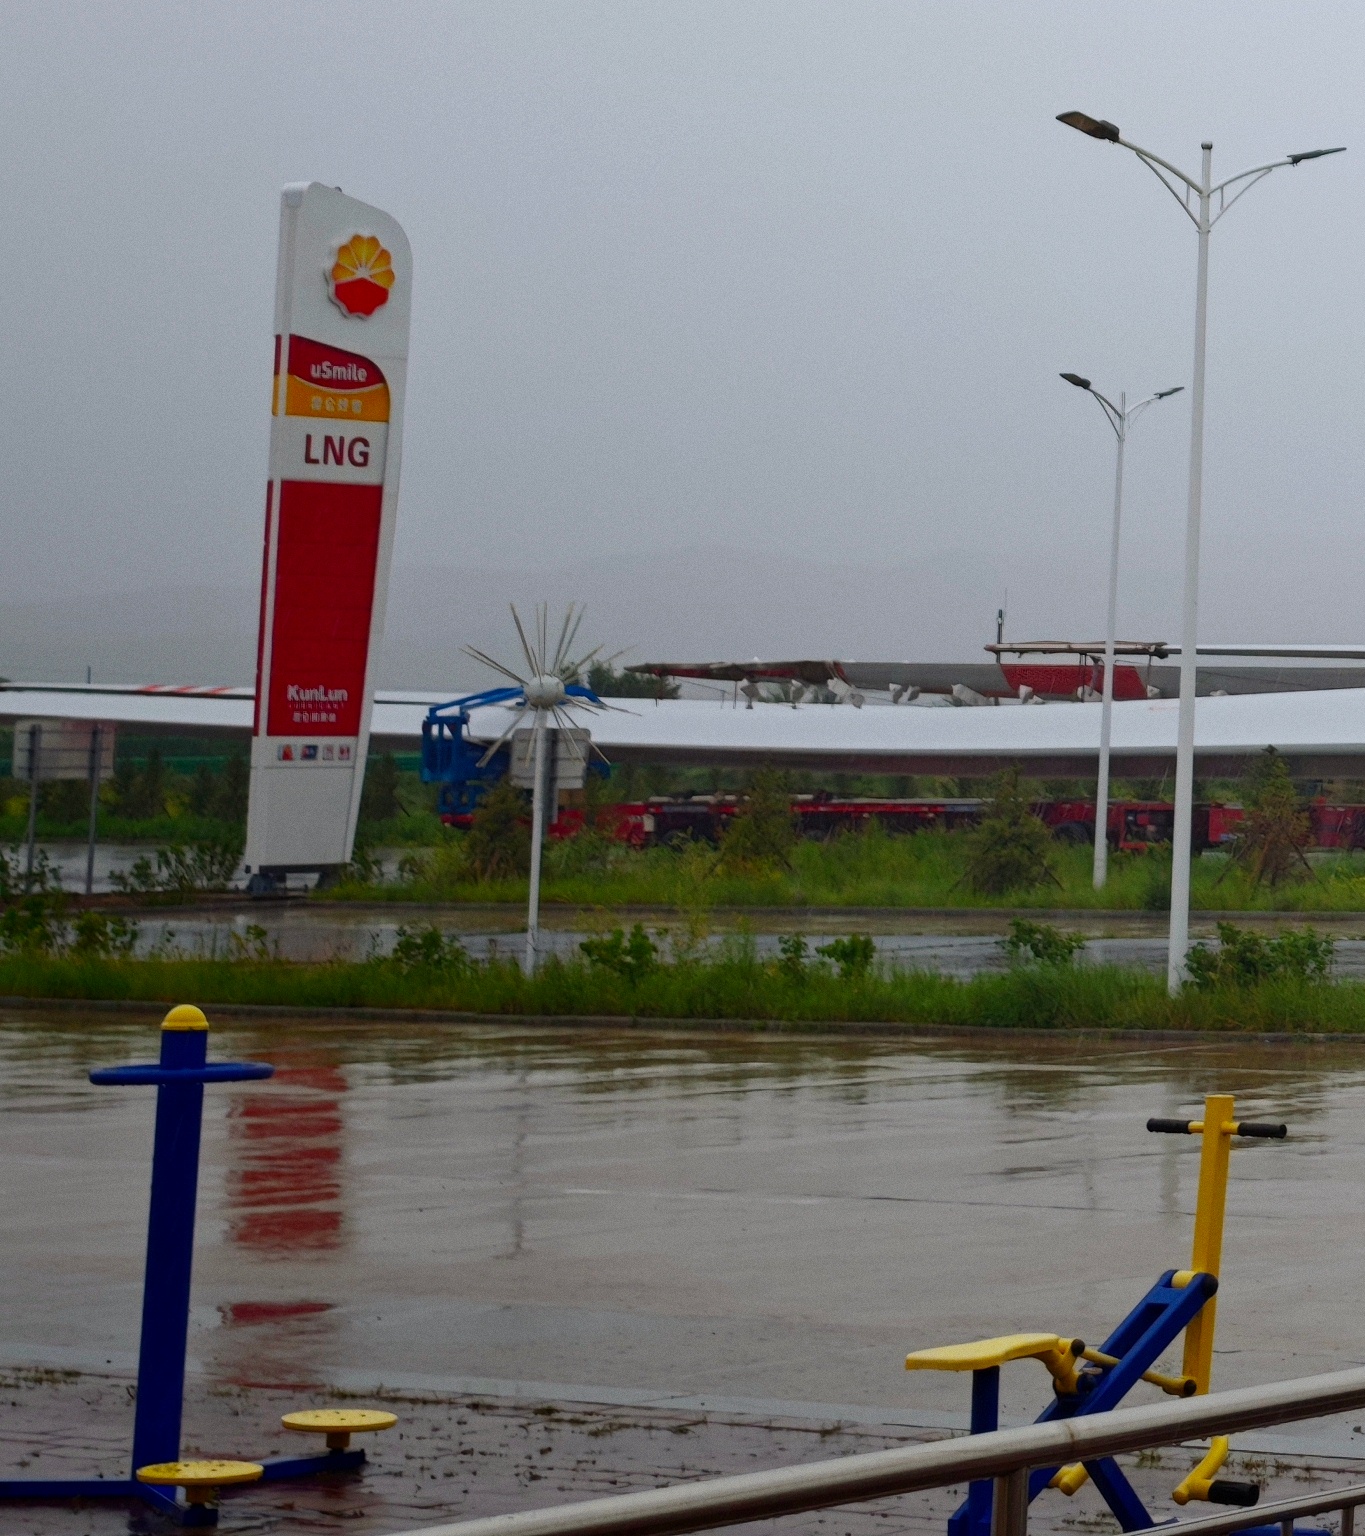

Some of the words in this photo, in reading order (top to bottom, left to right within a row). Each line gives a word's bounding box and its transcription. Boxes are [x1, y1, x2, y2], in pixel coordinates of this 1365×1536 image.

[310, 360, 368, 382] uSmile
[304, 433, 370, 468] LNG
[286, 684, 348, 702] KunLun
